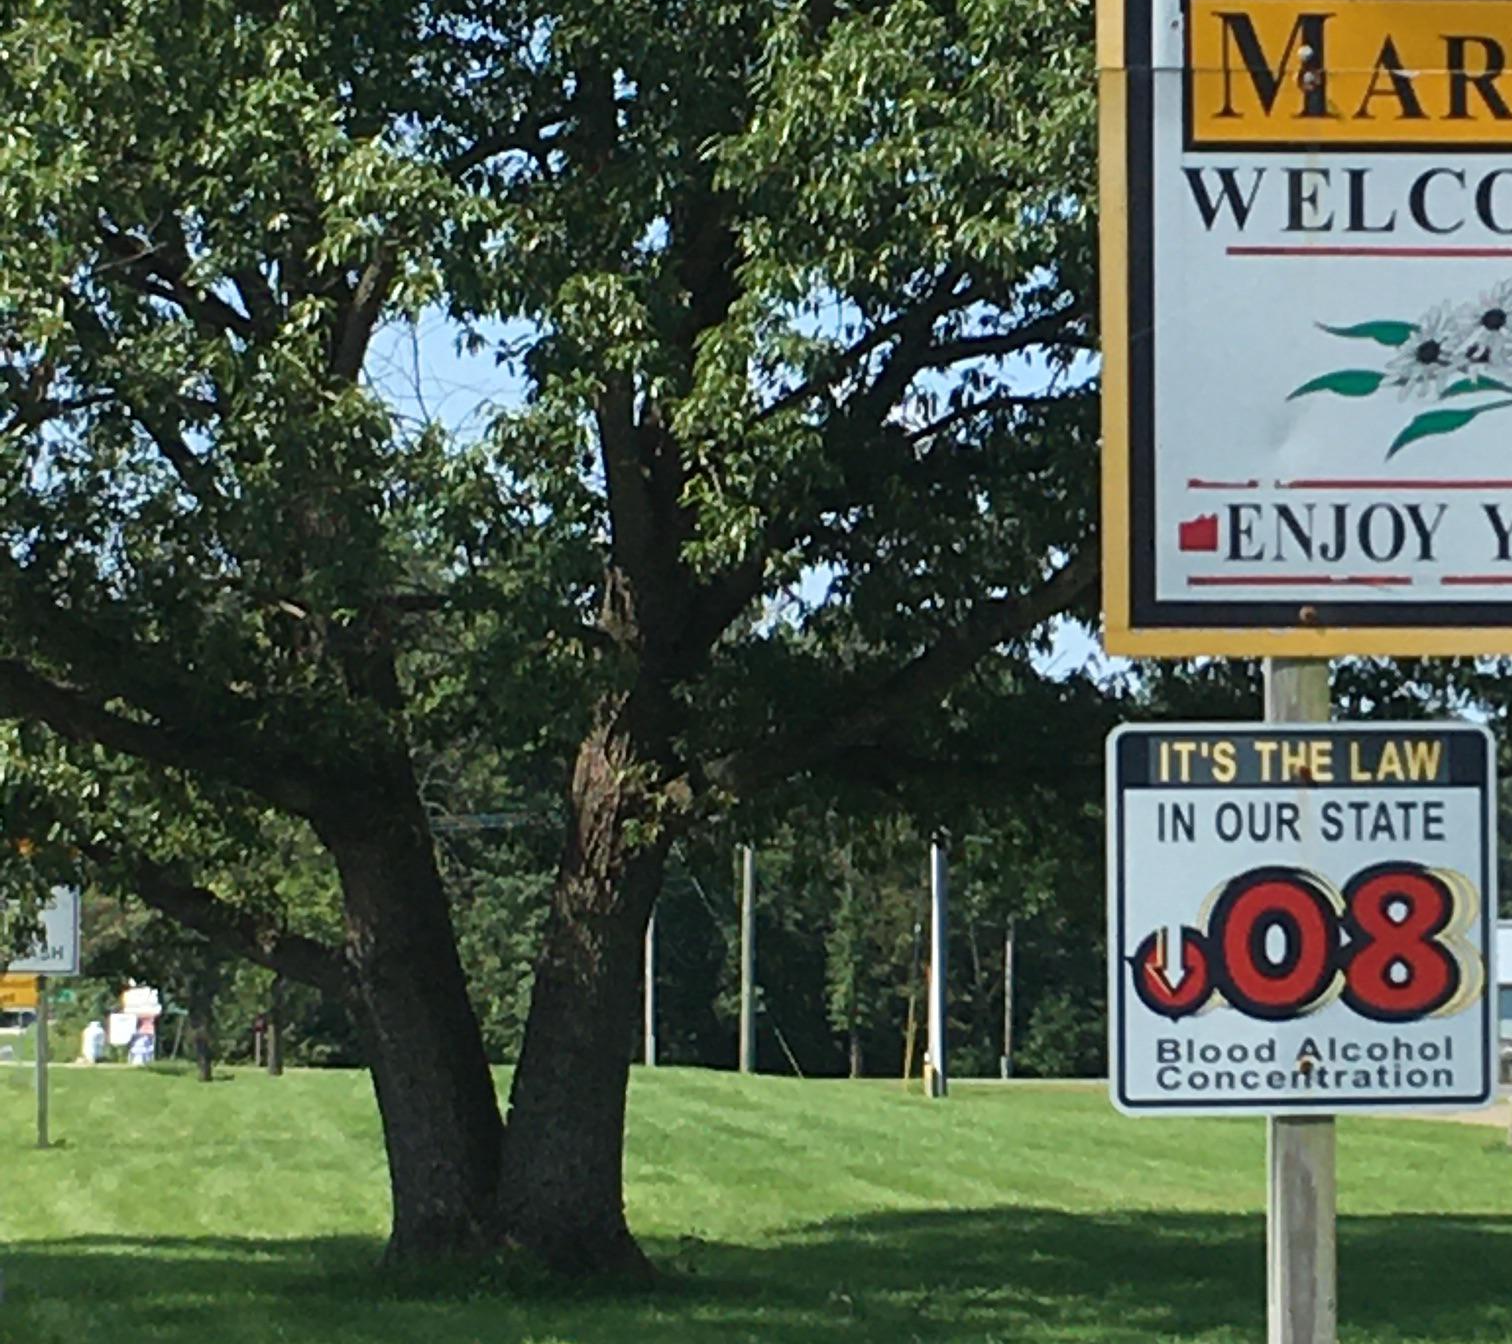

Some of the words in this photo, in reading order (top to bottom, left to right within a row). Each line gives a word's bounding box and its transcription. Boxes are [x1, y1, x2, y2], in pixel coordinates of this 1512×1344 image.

[1224, 502, 1448, 562] ENJOY
[1159, 741, 1237, 783] IT'S
[1254, 741, 1333, 782] THE
[1350, 741, 1442, 782] LAW
[1157, 802, 1195, 843] IN
[1215, 802, 1301, 842] OUR
[1320, 801, 1446, 842] STATE
[1156, 1038, 1276, 1064] Blood
[1297, 1036, 1453, 1064] Alcohol
[1156, 1064, 1455, 1091] Concentration
